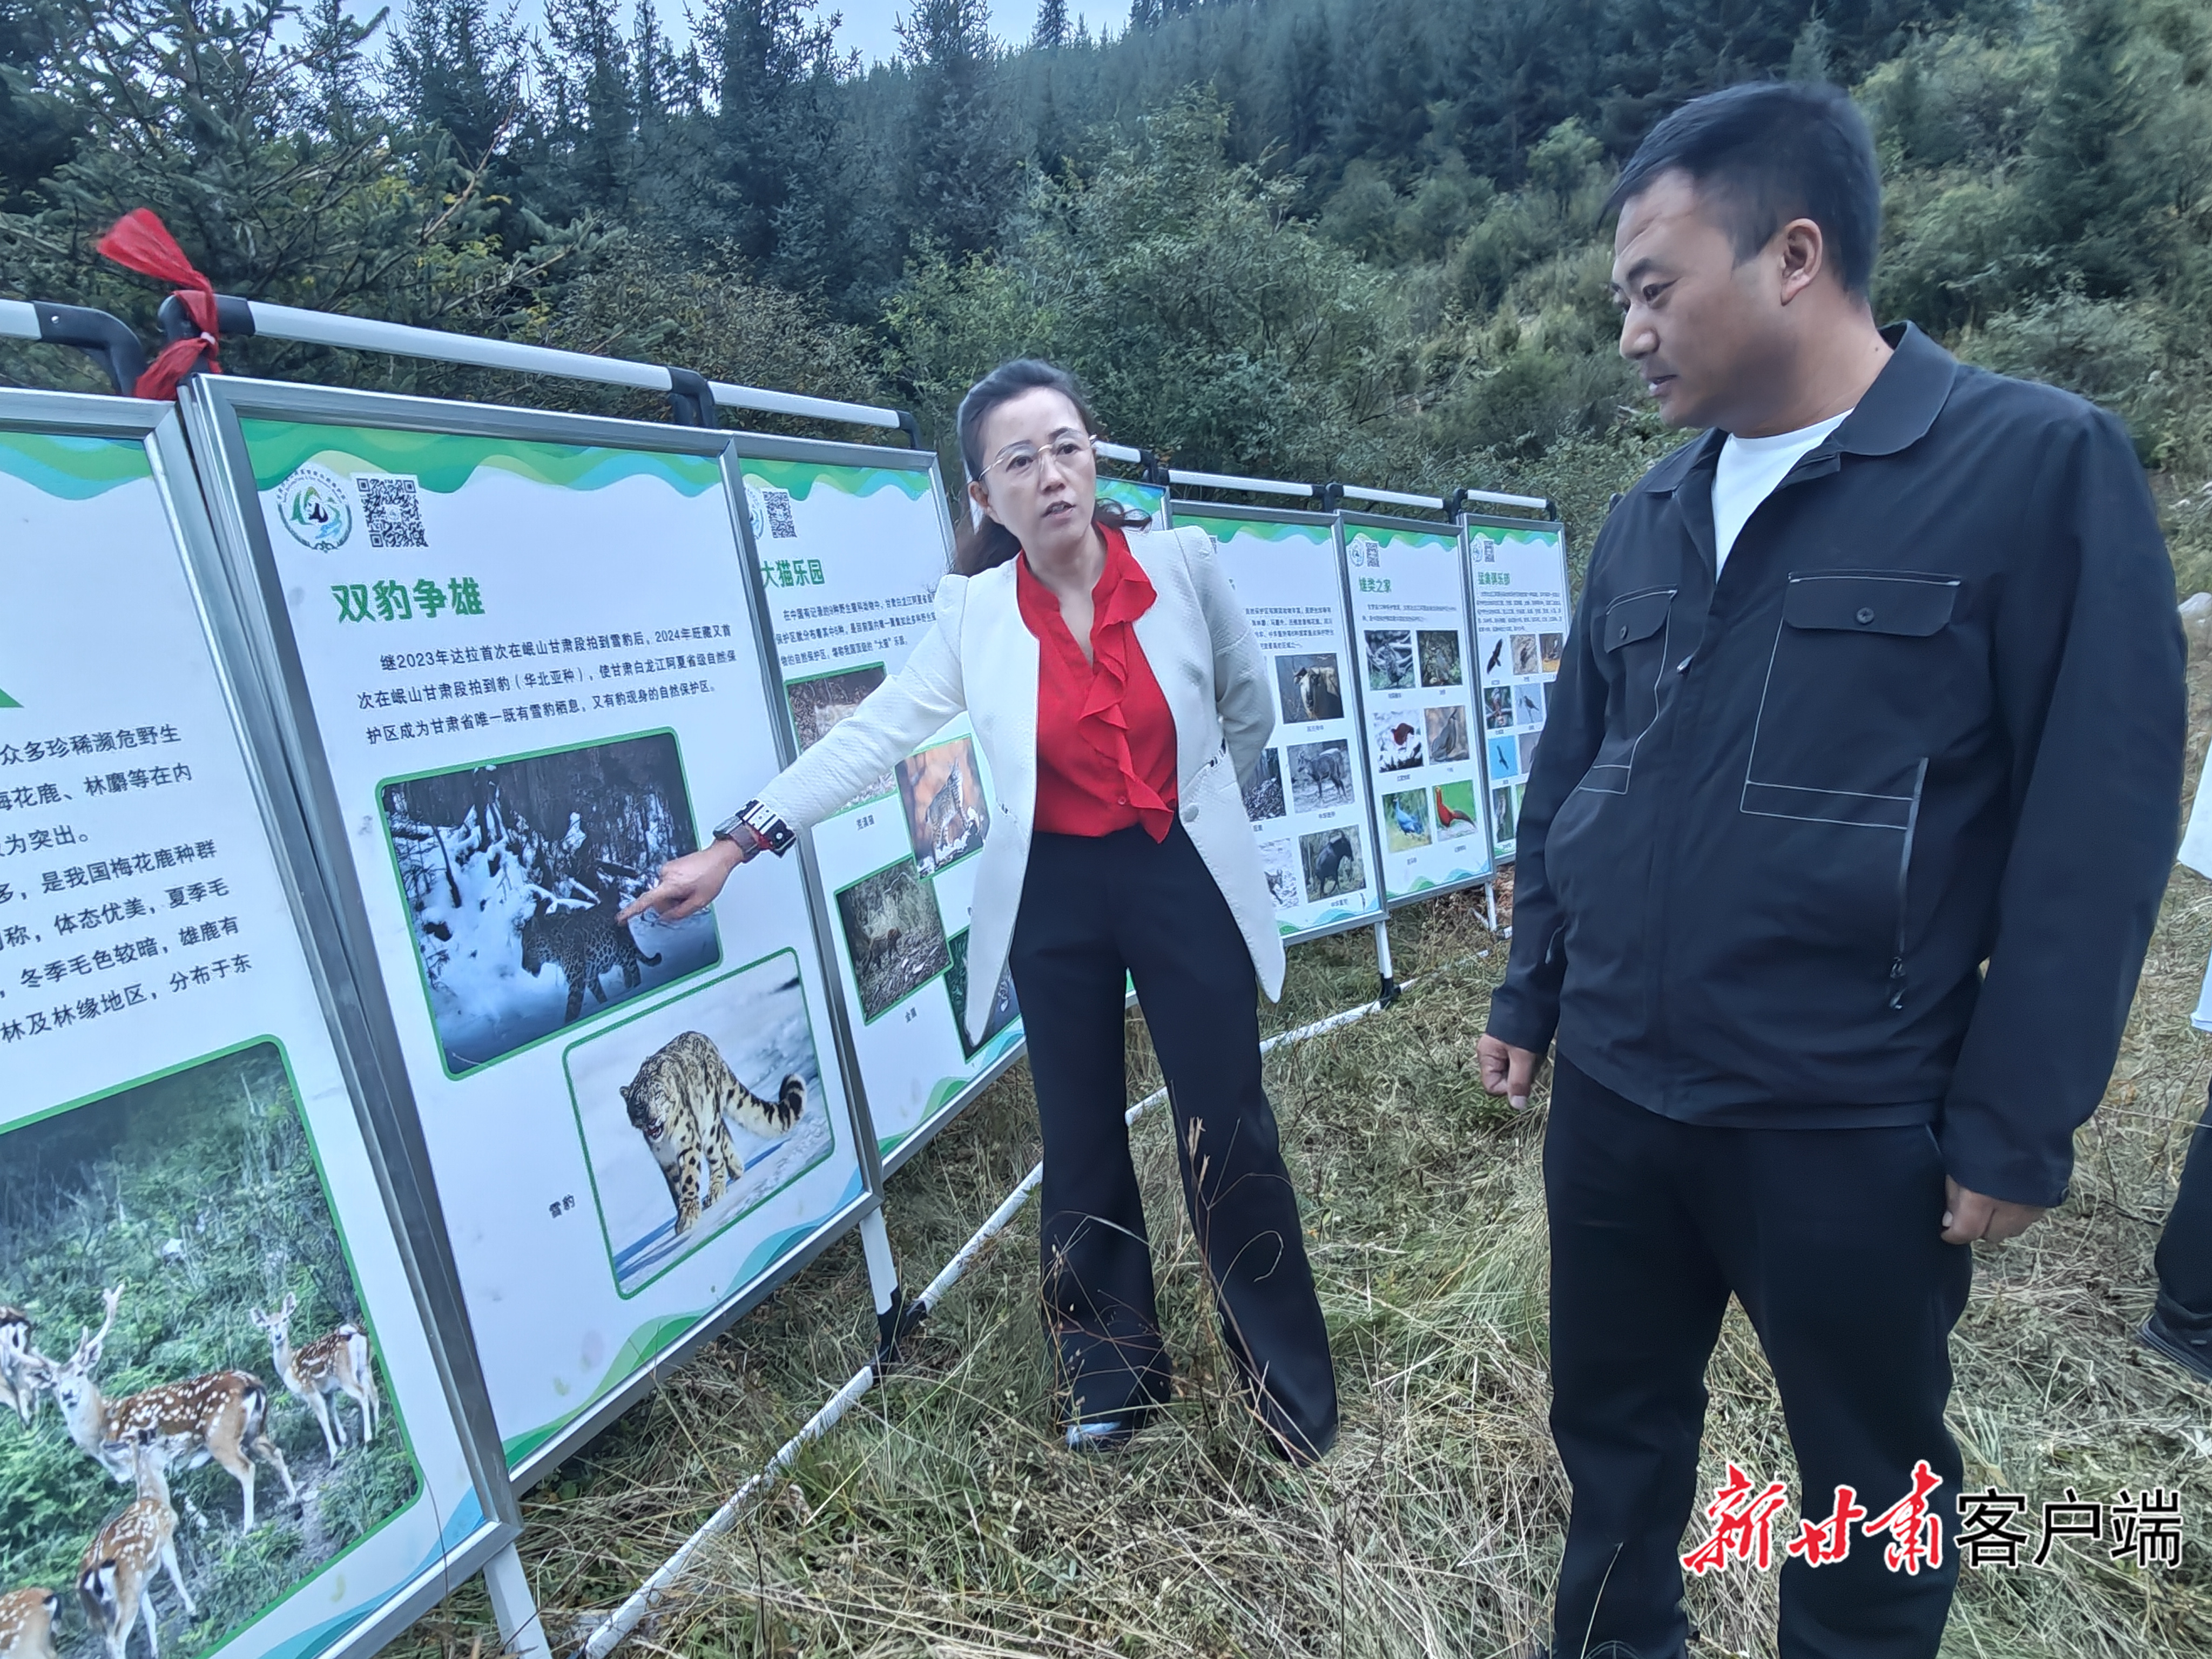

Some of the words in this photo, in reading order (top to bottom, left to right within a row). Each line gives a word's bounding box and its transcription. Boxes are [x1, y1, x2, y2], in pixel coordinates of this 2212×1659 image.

[760, 559, 825, 589] 大猫乐园
[331, 577, 485, 623] 双豹争雄
[1, 724, 181, 765] 众多珍稀濒危野生
[549, 1194, 576, 1218] 雪豹
